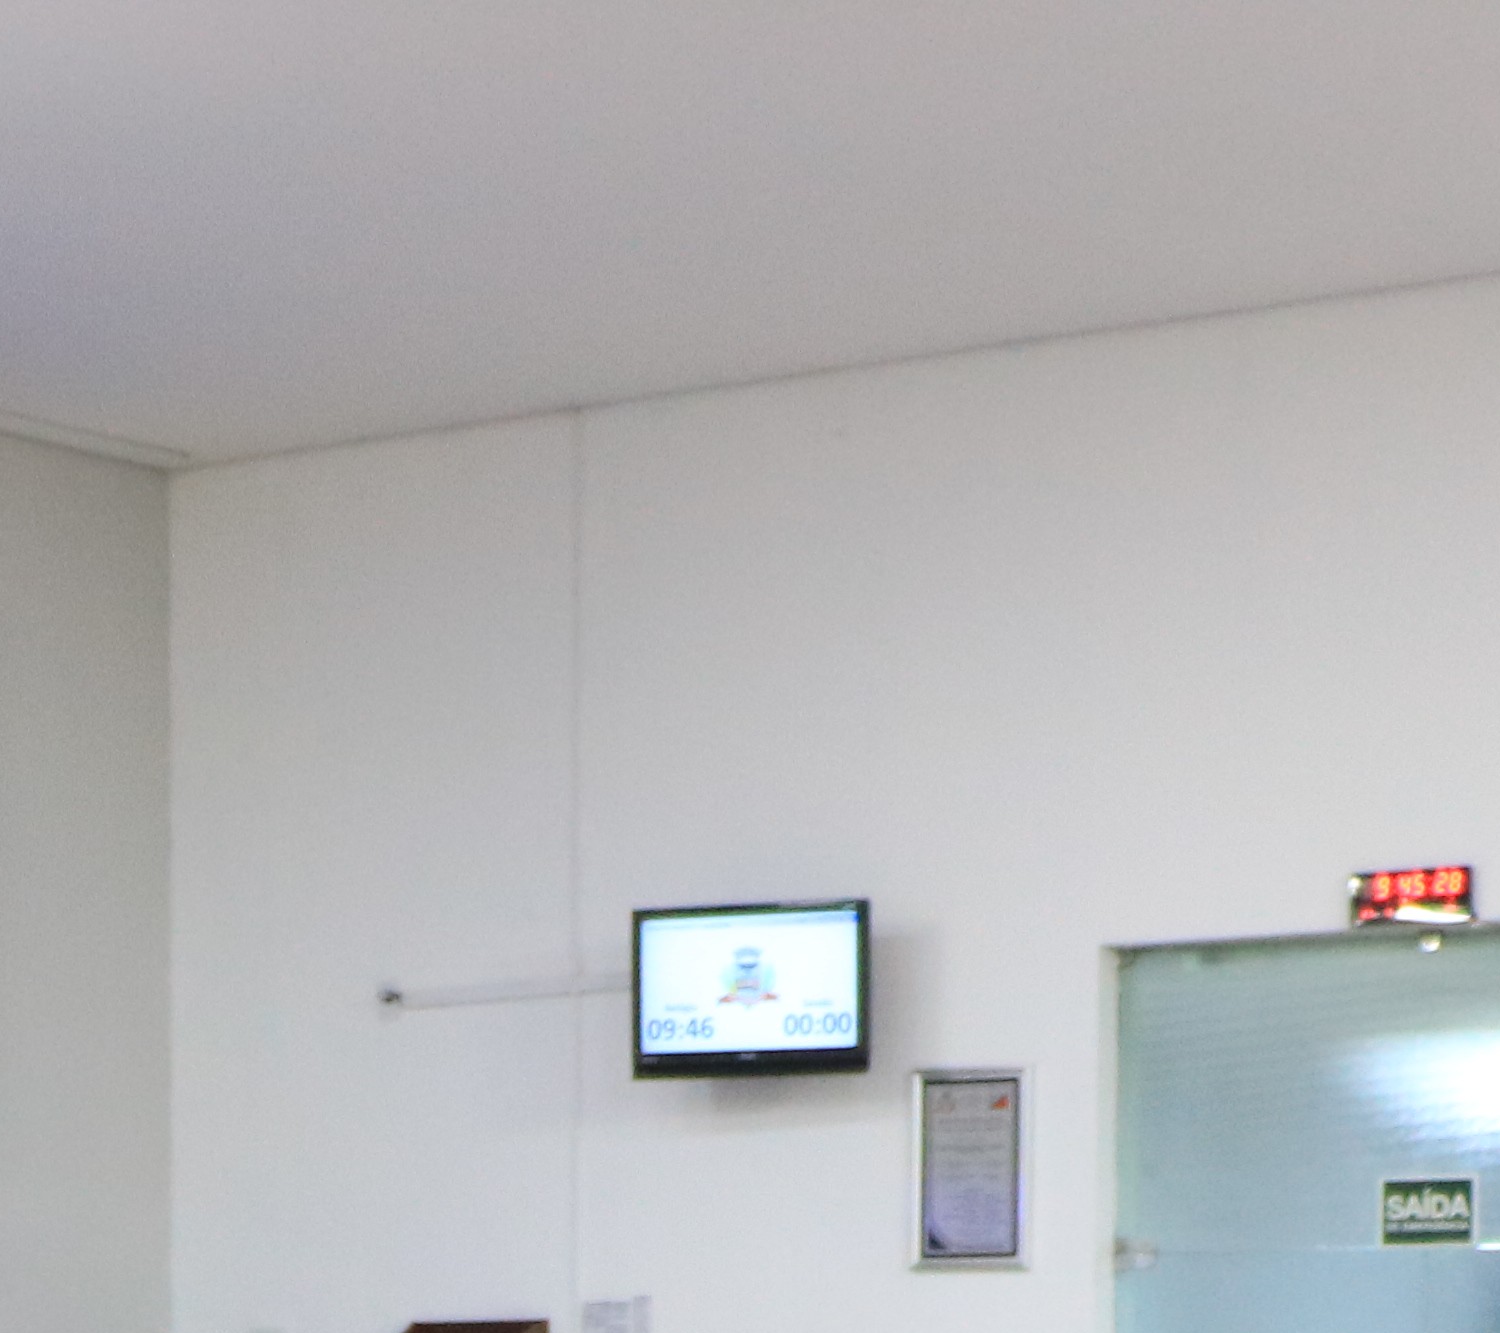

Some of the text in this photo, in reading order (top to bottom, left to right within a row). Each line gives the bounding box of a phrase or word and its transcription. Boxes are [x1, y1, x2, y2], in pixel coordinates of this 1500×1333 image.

[1435, 871, 1462, 892] 28
[647, 1017, 714, 1040] 09:46
[784, 1012, 852, 1034] 00:00
[1387, 1188, 1469, 1220] SAÍDA
